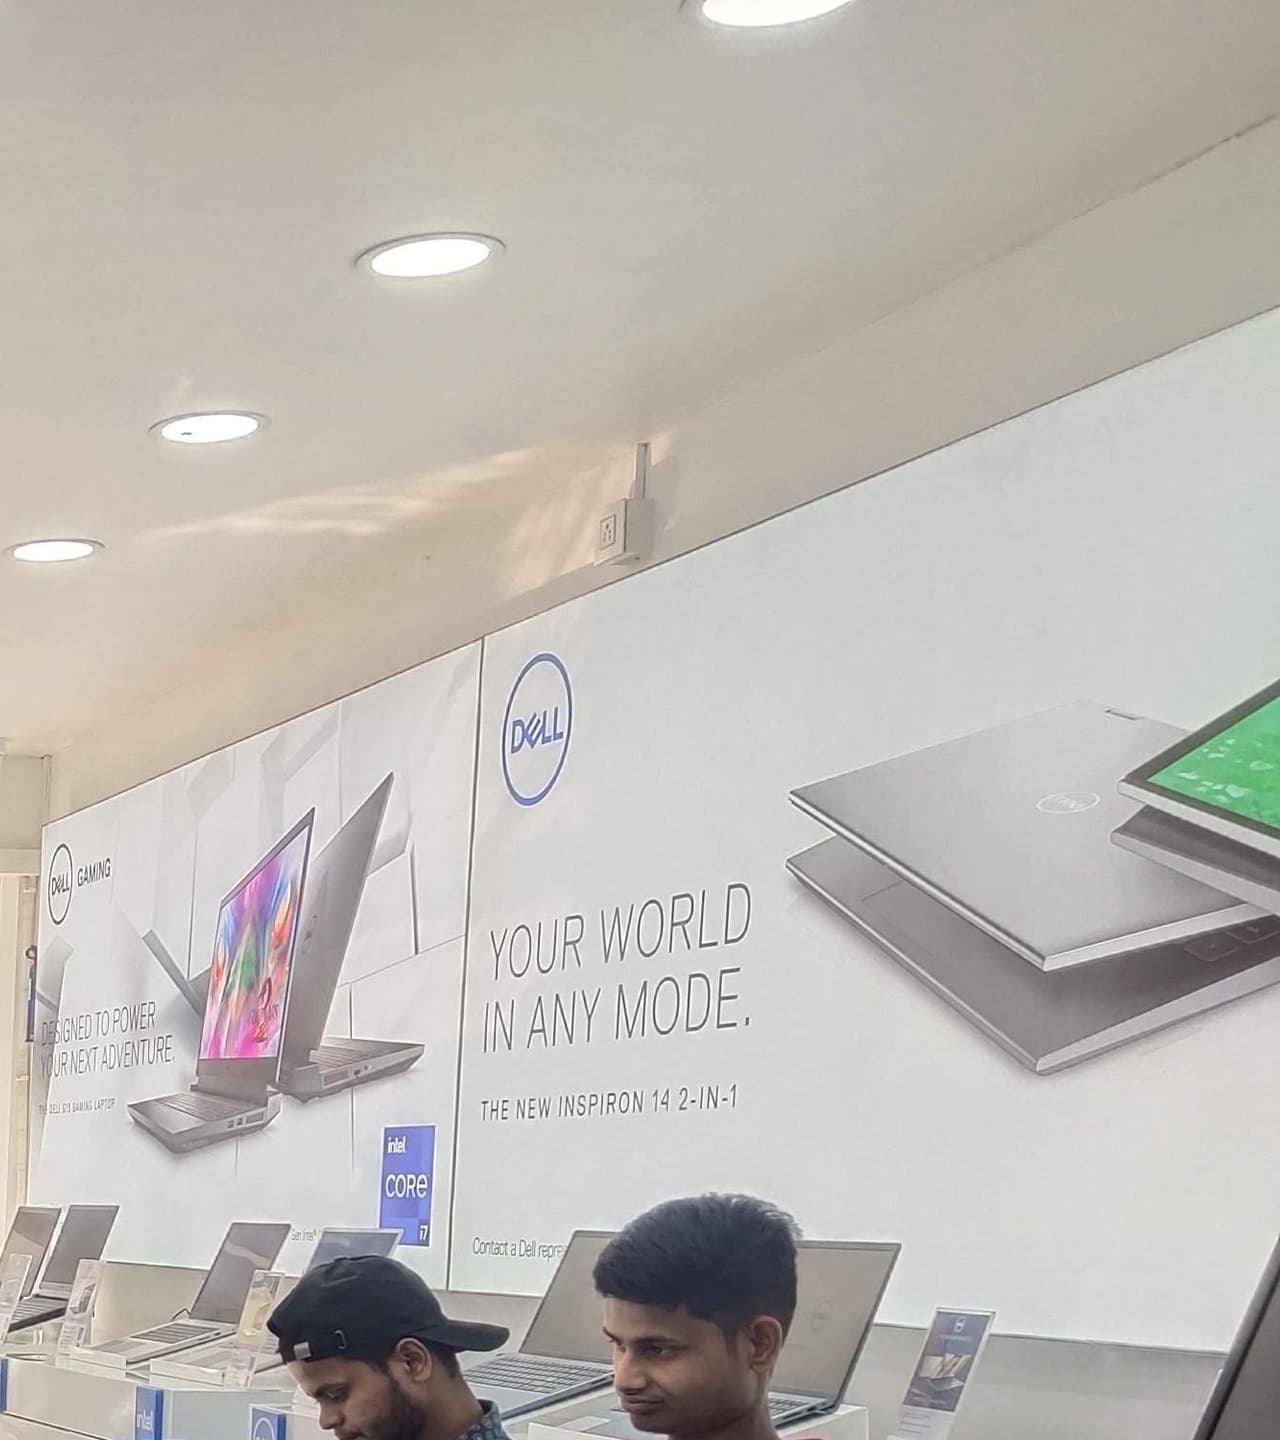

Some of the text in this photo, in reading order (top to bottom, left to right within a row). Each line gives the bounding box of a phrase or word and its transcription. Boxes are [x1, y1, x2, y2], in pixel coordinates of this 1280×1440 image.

[510, 706, 564, 755] DELL
[51, 857, 111, 896] DELL GAMING
[491, 881, 751, 981] YOUR WORLD
[42, 1001, 156, 1046] DESIGNED TO POWER
[483, 968, 751, 1054] IN ANY MODE.
[41, 1034, 175, 1079] YOUR NEXT ADVENTURE.
[481, 1083, 737, 1121] THE NEW INSPIRON 14 2-IN-1
[387, 1136, 406, 1153] intel
[419, 1225, 428, 1240] i7
[473, 1237, 508, 1256] Contact
[510, 1244, 517, 1256] a
[519, 1239, 536, 1257] Dell
